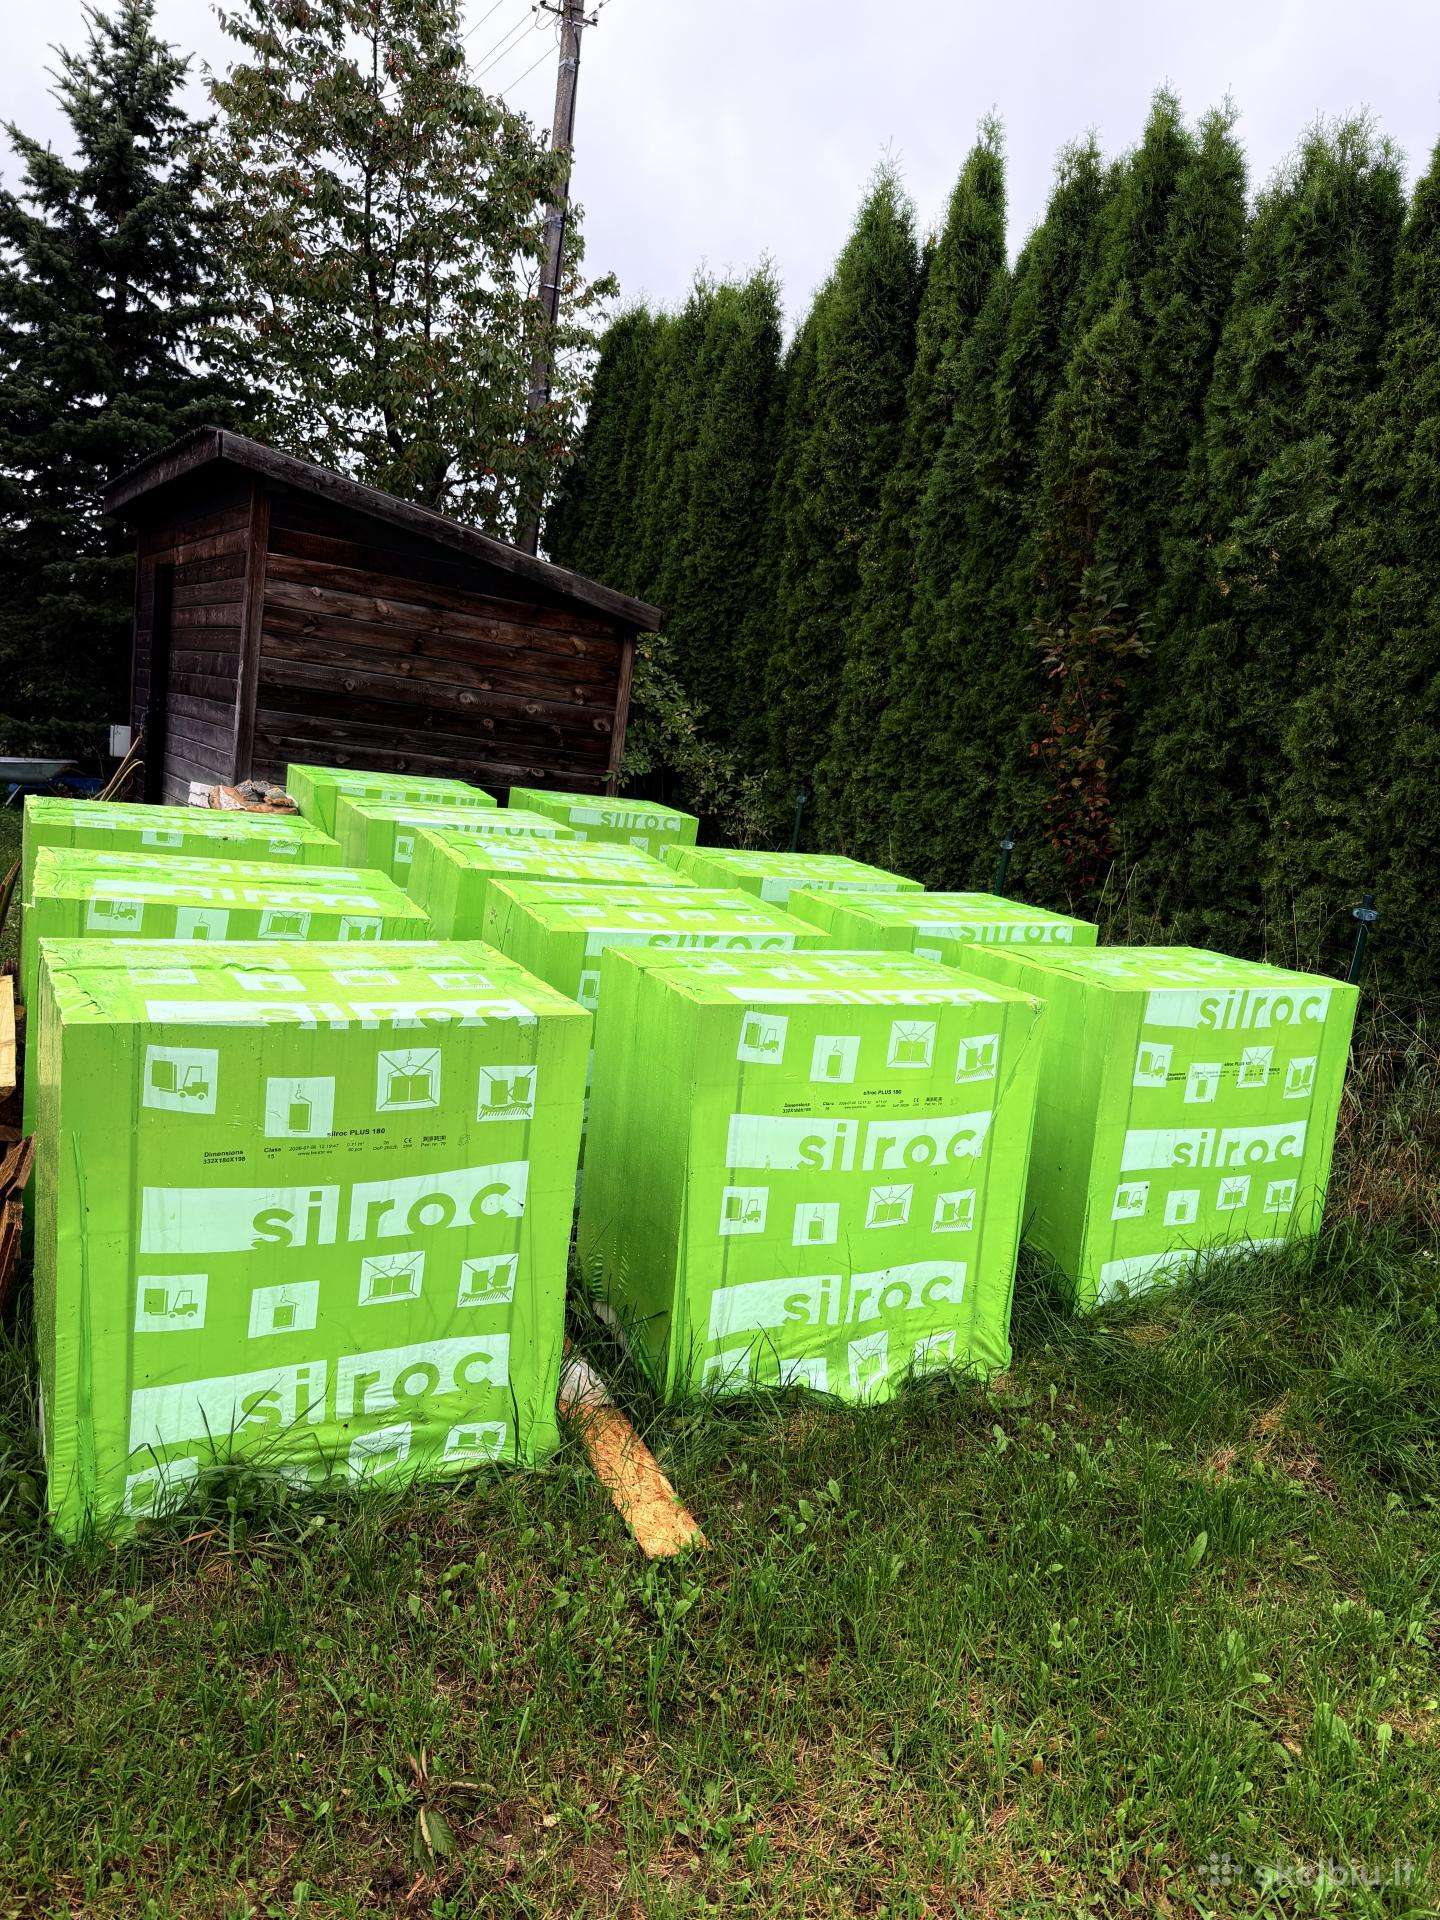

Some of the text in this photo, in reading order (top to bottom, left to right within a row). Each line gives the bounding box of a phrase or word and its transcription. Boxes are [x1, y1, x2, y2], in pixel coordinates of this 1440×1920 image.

[600, 812, 678, 830] silroc
[1198, 988, 1322, 1028] silroc
[349, 1128, 370, 1136] PLUS
[371, 1127, 386, 1135] 180
[798, 1119, 977, 1170] silroc
[1171, 1129, 1297, 1168] silroc
[203, 1149, 244, 1158] Dimensions
[251, 1182, 513, 1247] silroc
[782, 1272, 954, 1325] silroc
[240, 1353, 494, 1430] silroc
